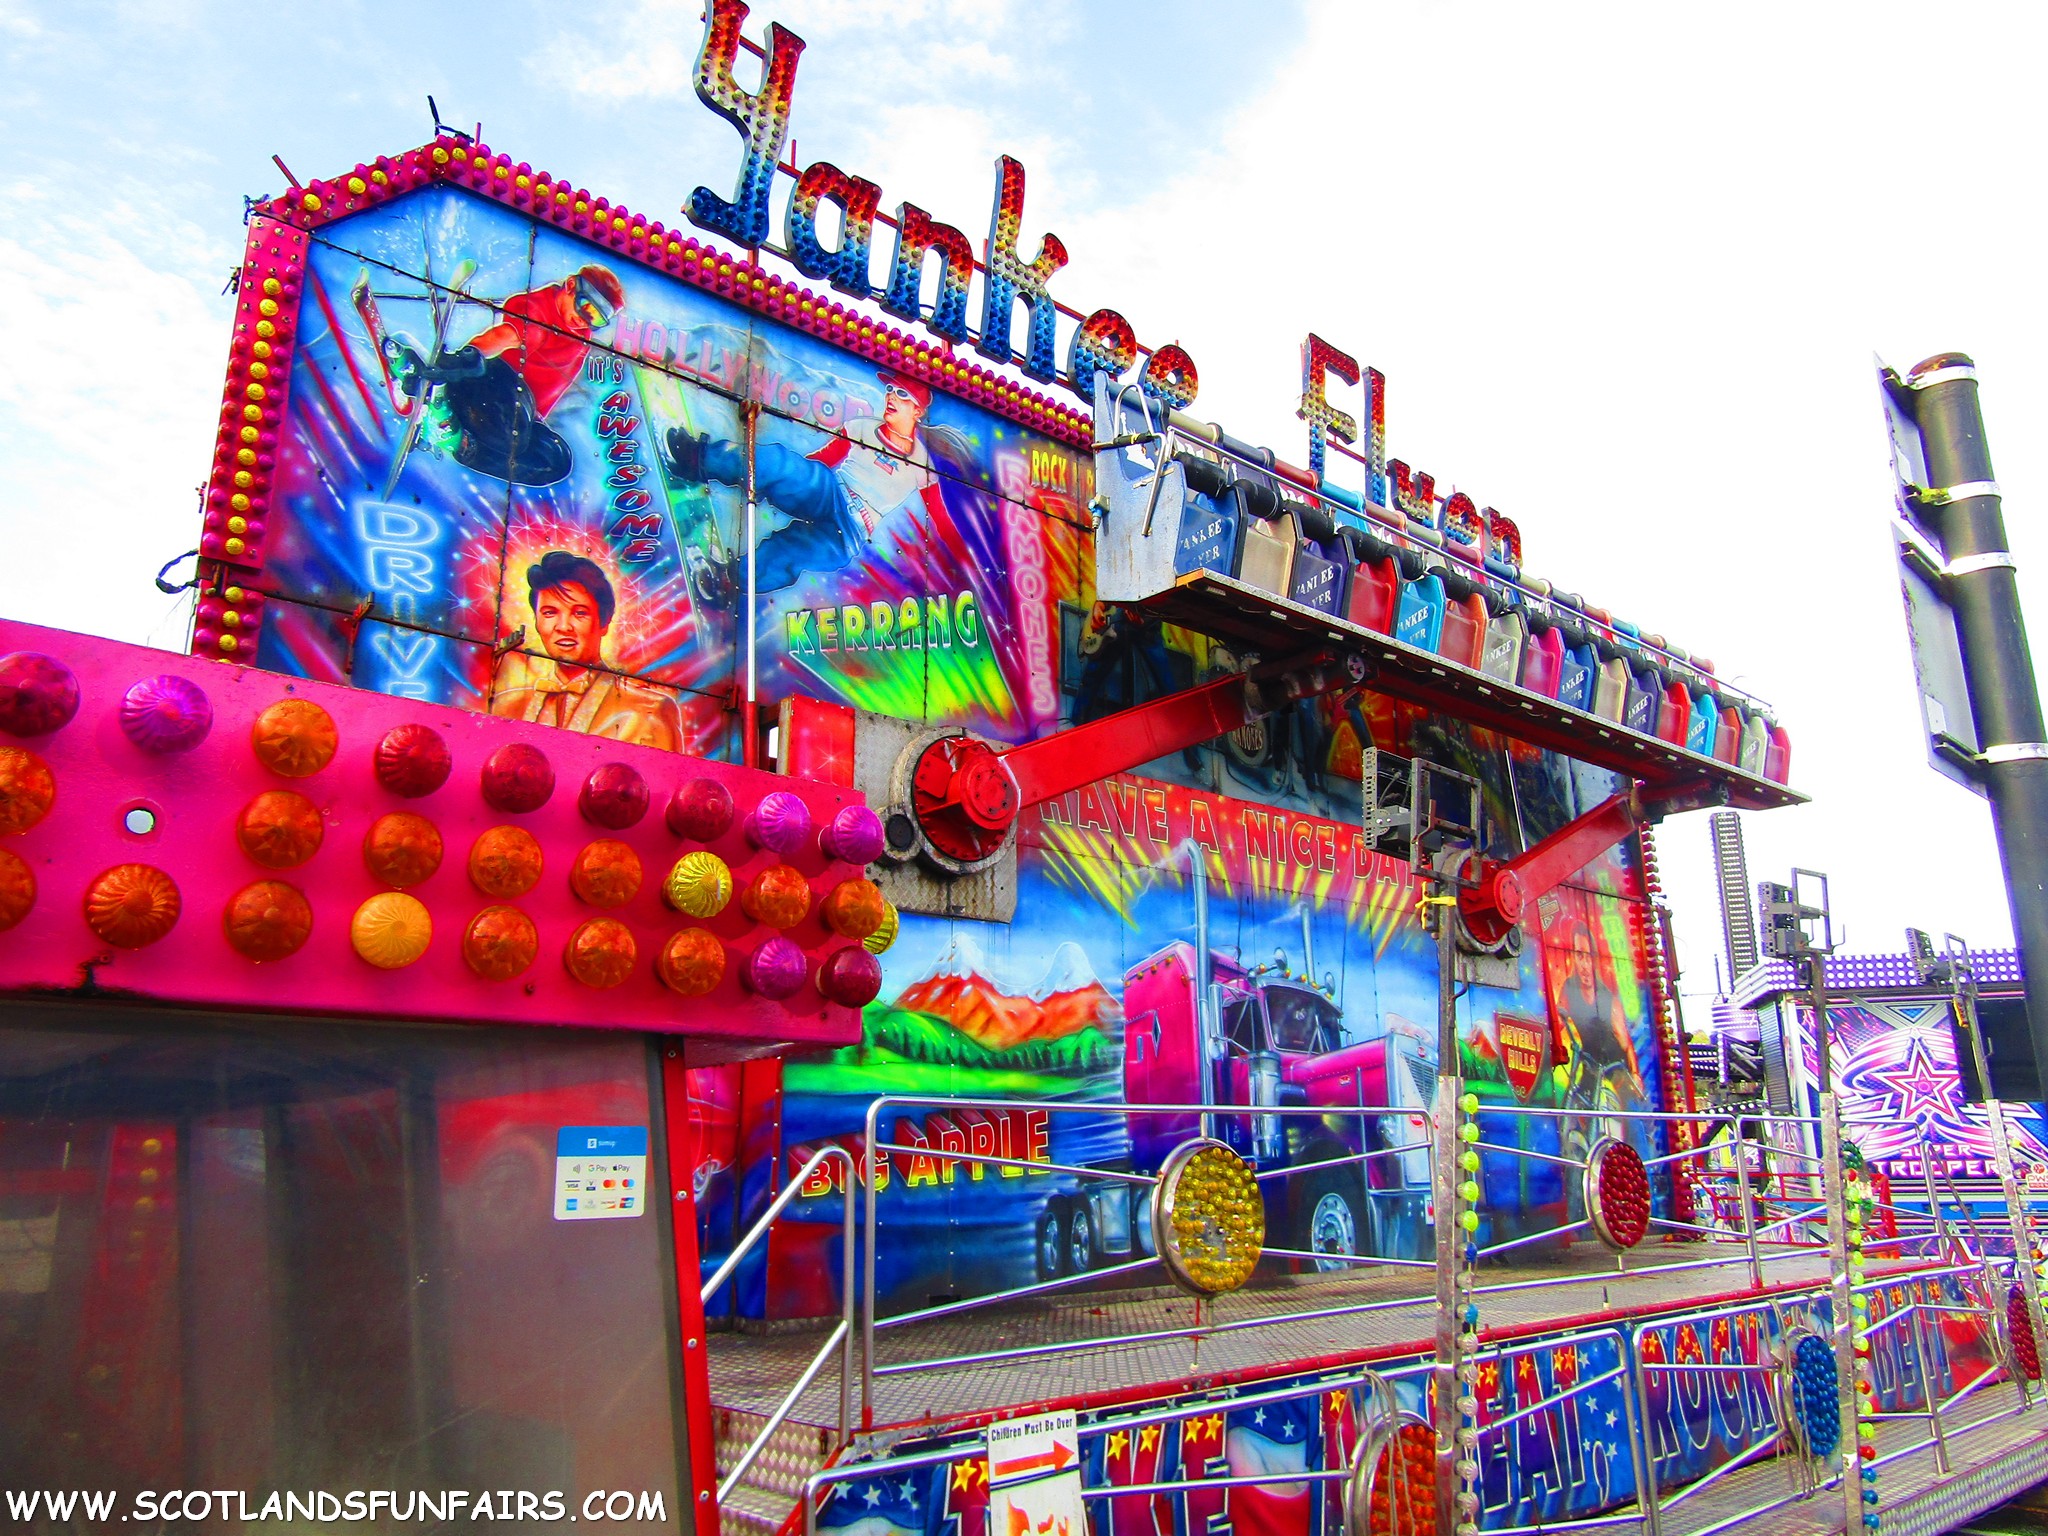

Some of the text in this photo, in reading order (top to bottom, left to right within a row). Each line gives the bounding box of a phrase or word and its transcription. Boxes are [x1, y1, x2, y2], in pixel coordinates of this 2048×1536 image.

[684, 0, 1198, 409] Yankee
[588, 355, 625, 383] IT'S
[597, 391, 663, 563] AWESOME
[1030, 450, 1067, 493] ROCK
[786, 590, 979, 656] KERRANG
[1397, 605, 1429, 632] ANKEE
[1040, 781, 1169, 843] HAVE
[1190, 800, 1221, 854] A
[1242, 809, 1337, 873] NICE
[1499, 1023, 1542, 1052] BEVERLY
[1507, 1048, 1537, 1075] HILLS
[800, 1110, 1051, 1198] BIG APPLE
[991, 1417, 1073, 1441] Children Must Be Over
[1426, 1345, 1610, 1514] EAT,
[1642, 1312, 1778, 1460] ROCK
